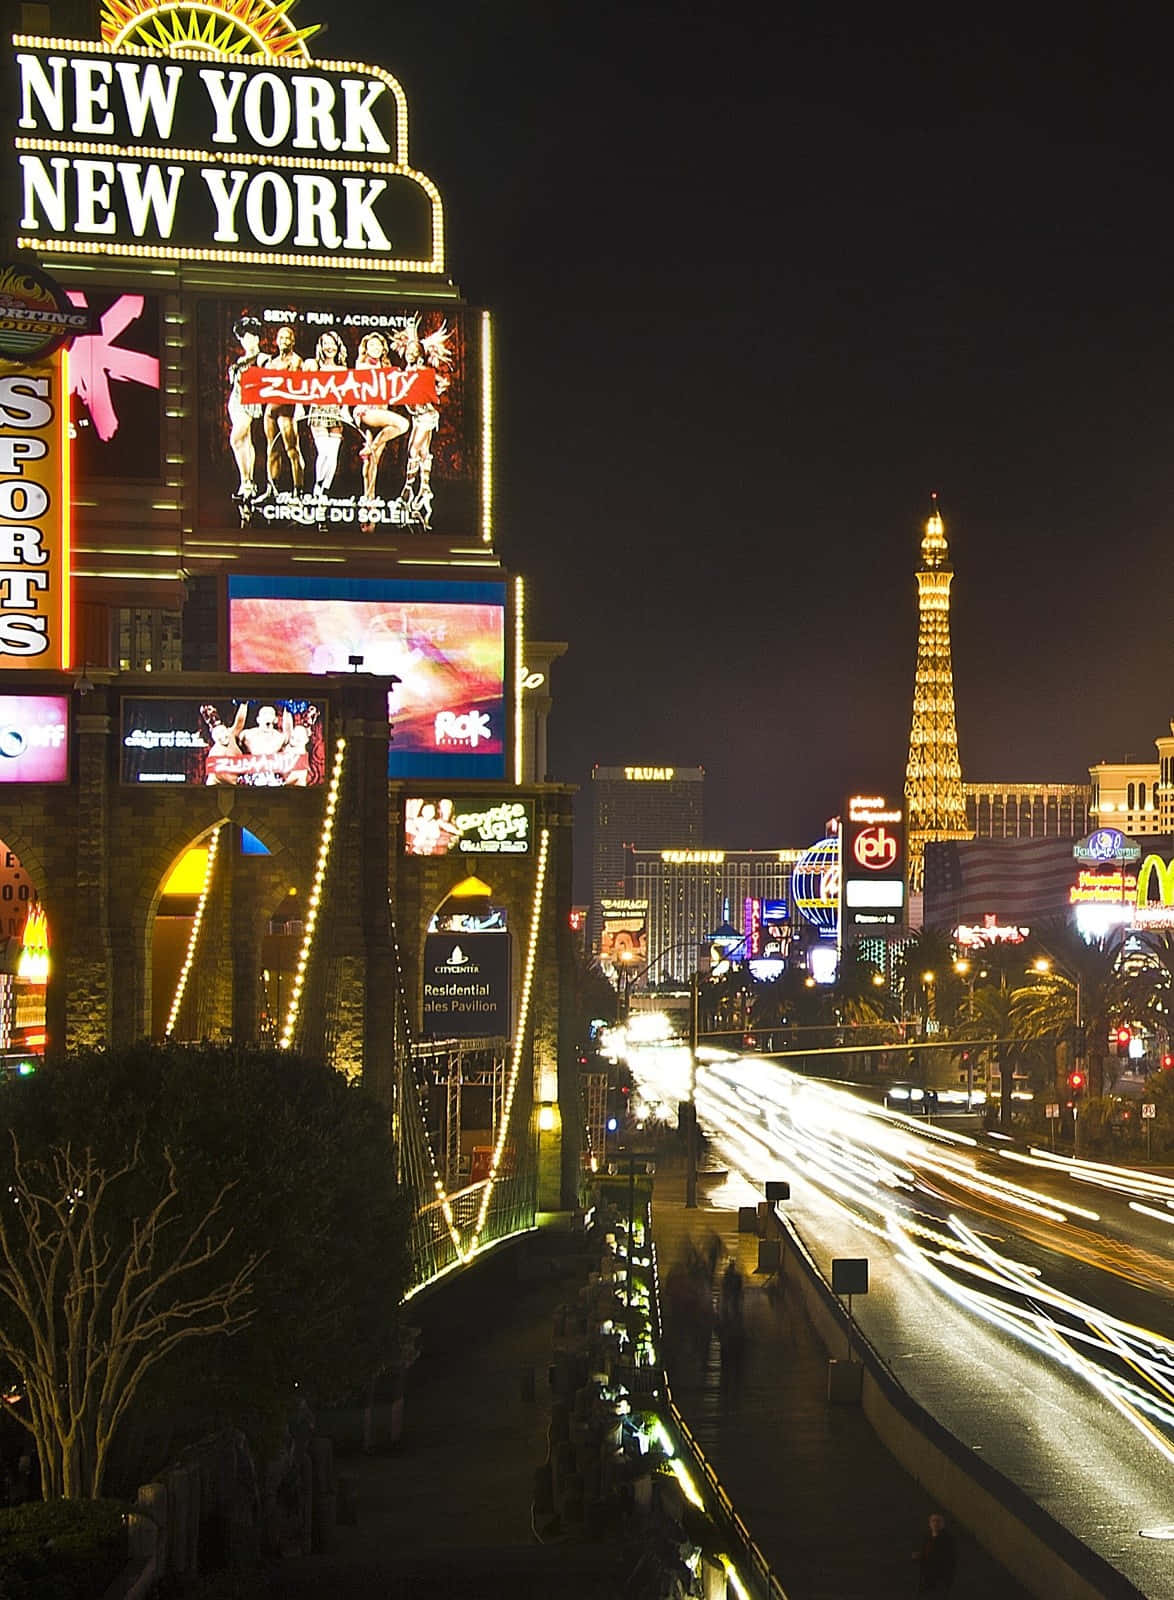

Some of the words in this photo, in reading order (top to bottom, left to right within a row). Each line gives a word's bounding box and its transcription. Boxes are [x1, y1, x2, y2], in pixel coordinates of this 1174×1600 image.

[16, 54, 183, 140] NEW
[200, 69, 391, 154] YORK
[18, 154, 184, 239] NEW
[201, 169, 392, 252] YORK
[264, 309, 297, 323] SEXY
[307, 312, 333, 325] FUN
[343, 315, 416, 328] ACROBATIC
[258, 369, 419, 406] ZUMANITY
[0, 376, 52, 656] SPORTS
[263, 505, 326, 525] CIRQUE
[330, 507, 355, 523] DU
[358, 508, 415, 524] SOLEIL
[624, 767, 674, 781] TRUMP
[424, 984, 490, 997] Residential
[451, 999, 498, 1012] Pavilion
